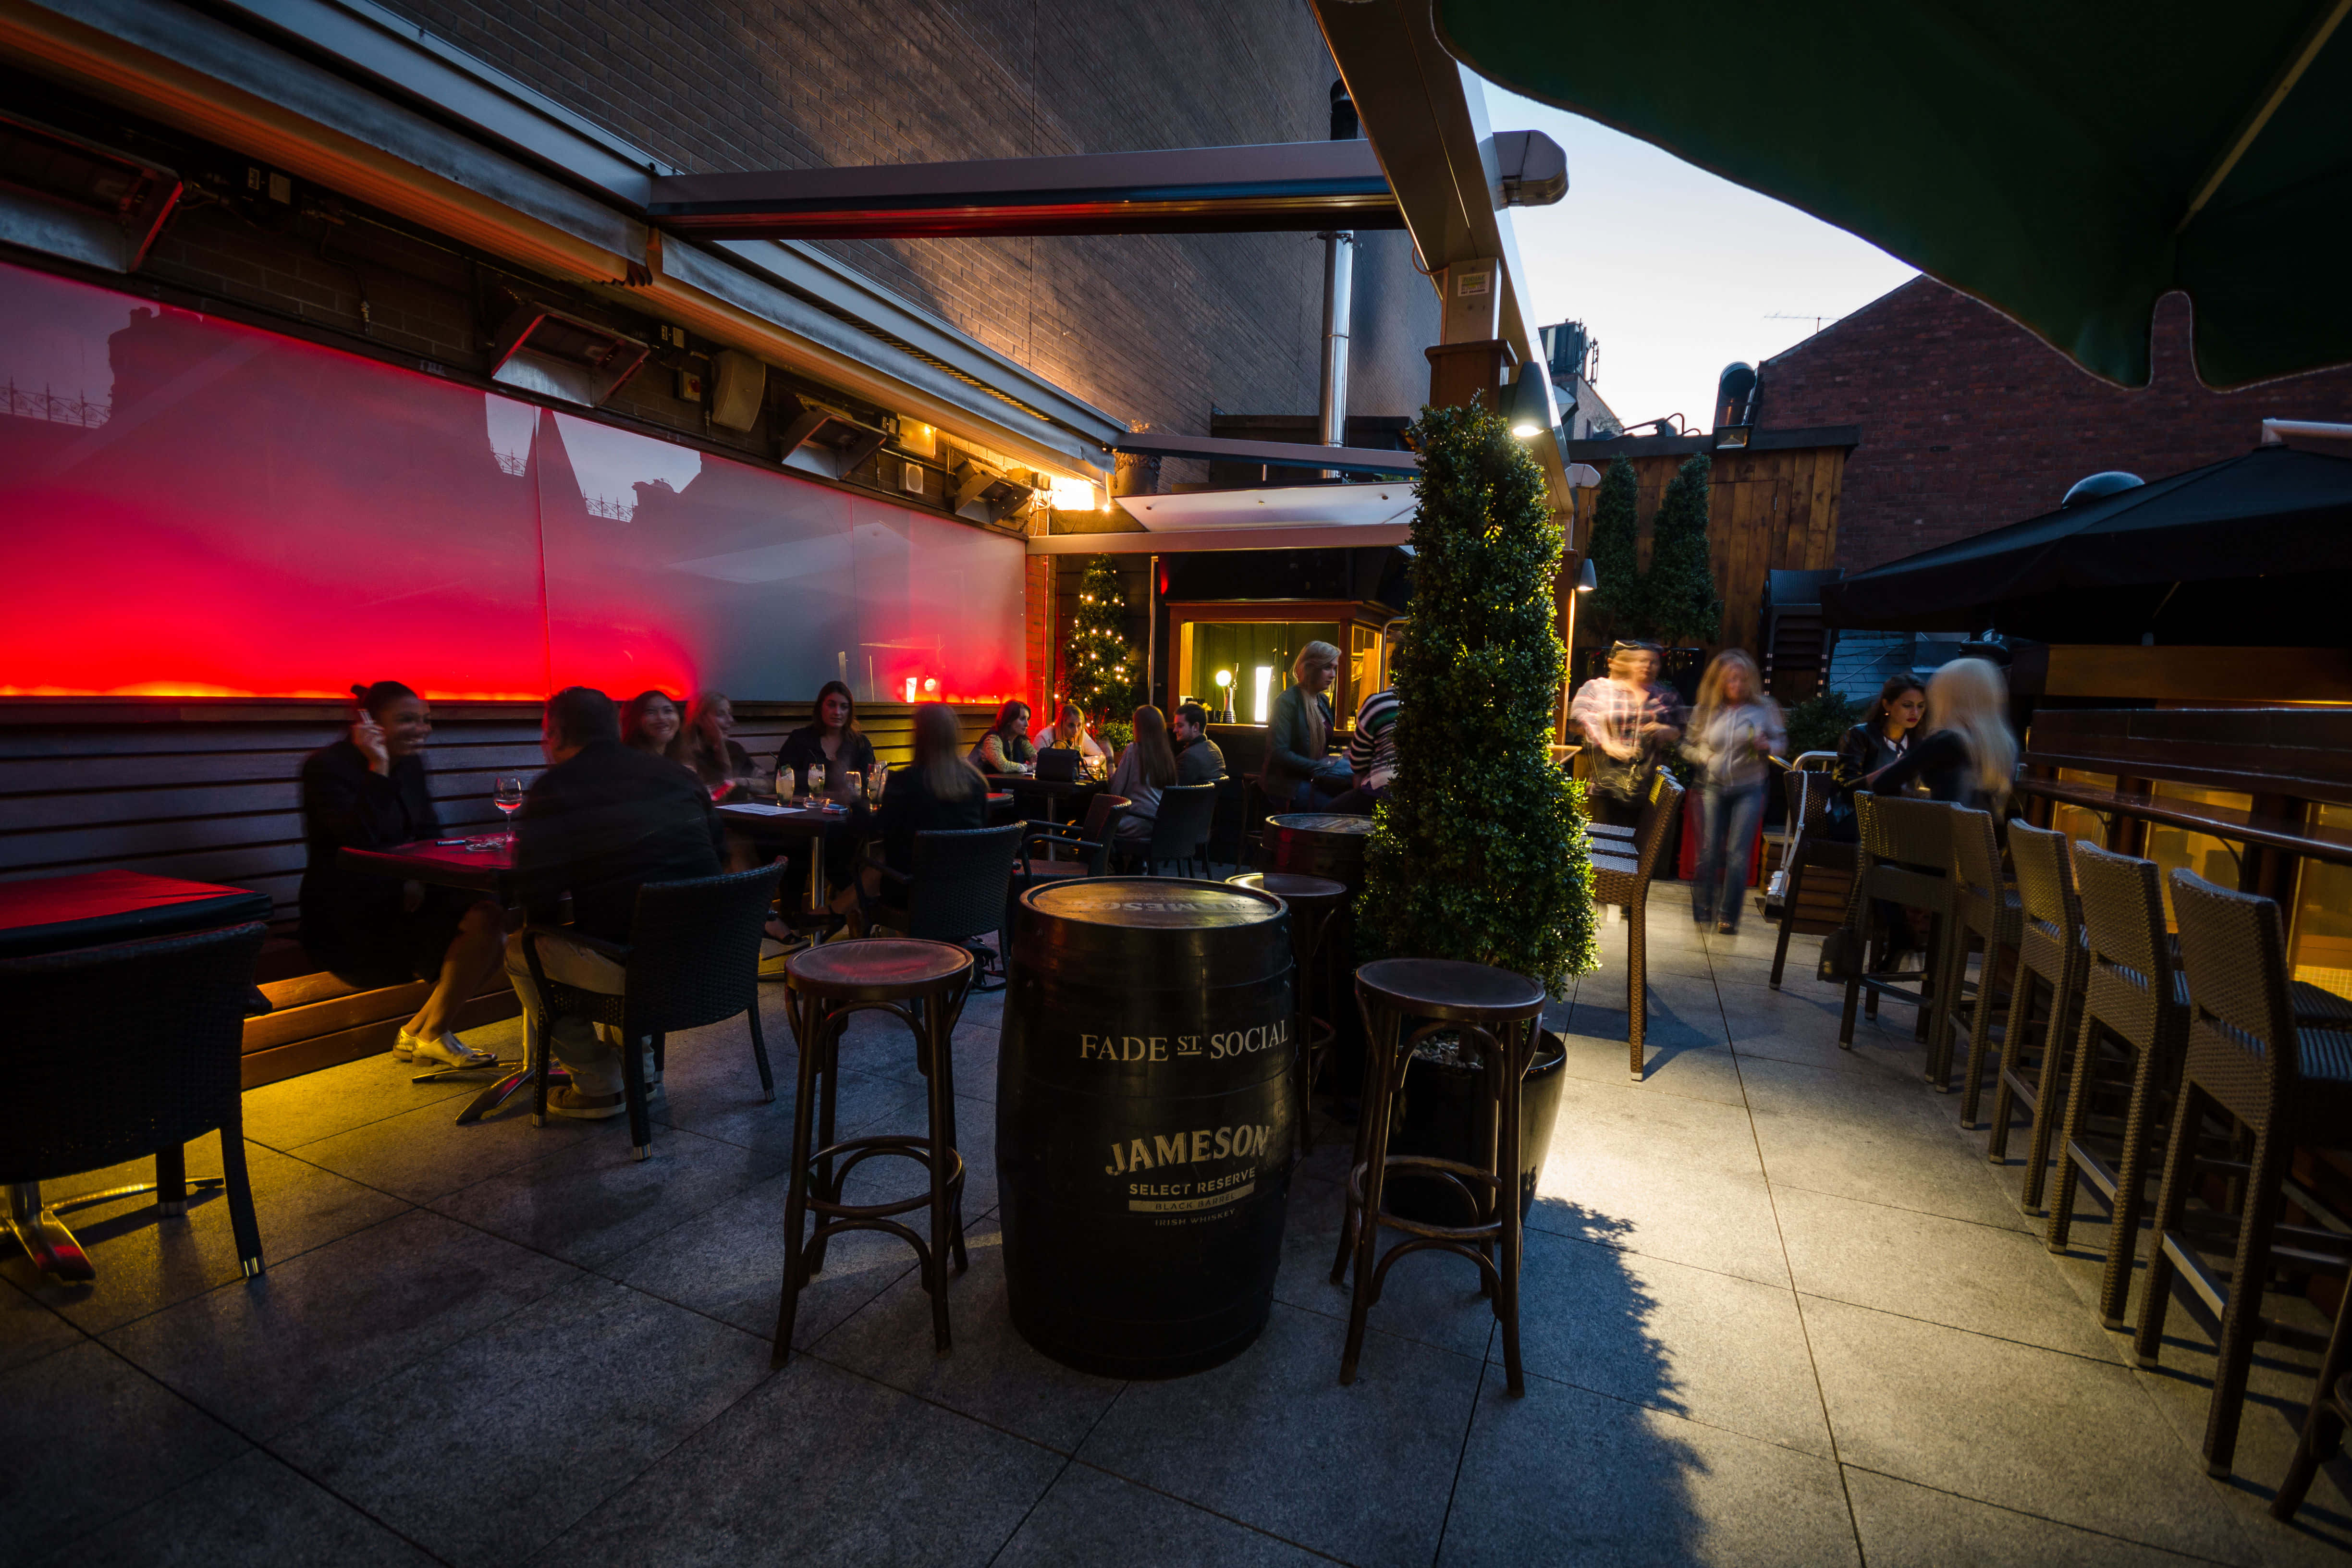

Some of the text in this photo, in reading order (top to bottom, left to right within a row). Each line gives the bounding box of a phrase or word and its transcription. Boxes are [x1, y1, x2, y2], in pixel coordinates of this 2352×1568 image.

[1079, 1034, 1169, 1062] FADE
[1210, 1020, 1288, 1060] SOCIAL
[1105, 1124, 1271, 1176] JAMESON
[1129, 1166, 1256, 1196] SELECT RESERVE
[1155, 1193, 1235, 1211] BLACK BARREL
[1155, 1208, 1237, 1226] IRISH WHISKEY
